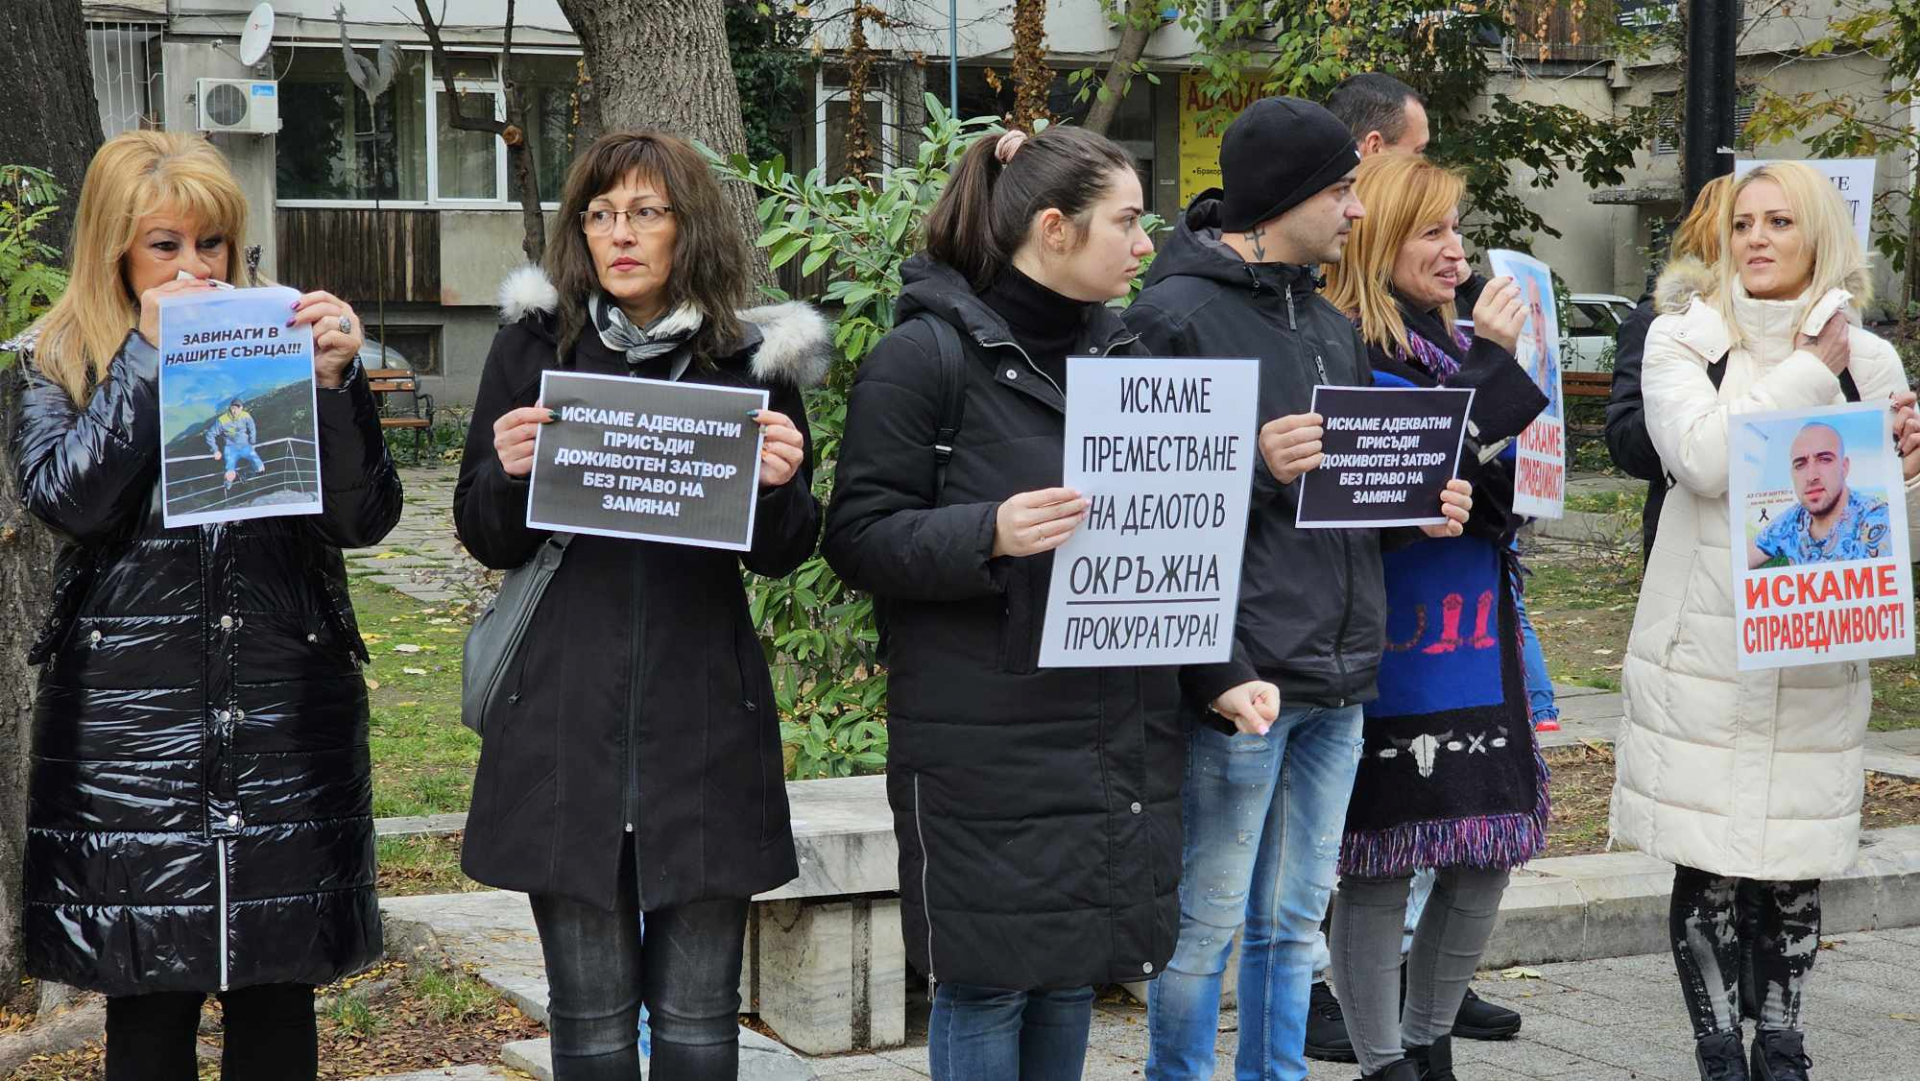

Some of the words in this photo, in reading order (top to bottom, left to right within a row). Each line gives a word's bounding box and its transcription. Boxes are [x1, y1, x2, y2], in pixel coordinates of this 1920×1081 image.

[182, 328, 264, 346] ЗАВИНАГИ
[269, 327, 279, 338] В
[165, 348, 227, 365] НАШИТЕ
[231, 343, 302, 358] СЪРЦА!!!
[1120, 376, 1212, 414] ИСКАМЕ
[561, 406, 635, 428] ИСКАМЕ
[637, 414, 741, 438] АДЕКВАТНИ
[1327, 417, 1381, 431] ИСКАМЕ
[1381, 416, 1452, 433] АДЕКВАТНИ
[603, 431, 695, 455] ПРИСЪДИ!
[1082, 435, 1240, 473] ПРЕМЕСТВАНЕ
[1356, 435, 1420, 451] ПРИСЪДИ!
[1520, 421, 1562, 458] ИСКАМЕ
[555, 448, 666, 473] ДОЖИВОТЕН
[669, 459, 737, 480] ЗАТВОР
[1320, 453, 1400, 470] ДОЖИВОТЕН
[1401, 452, 1446, 467] ЗАТВОР
[583, 472, 615, 489] БЕЗ
[618, 476, 676, 495] ПРАВО
[679, 482, 704, 498] НА
[1339, 473, 1363, 486] БЕЗ
[1365, 472, 1406, 485] ПРАВО
[1407, 471, 1424, 484] НА
[602, 495, 680, 517] ЗАМЯНА!
[1352, 490, 1407, 504] ЗАМЯНА!
[1088, 495, 1116, 530] НА
[1069, 554, 1220, 595] ОКРЪЖНА
[1745, 564, 1898, 610] ИСКАМЕ
[1063, 613, 1219, 650] ПРОКУРАТУРА!
[1743, 602, 1905, 654] СПРАВЕДЛИВОСТ!
